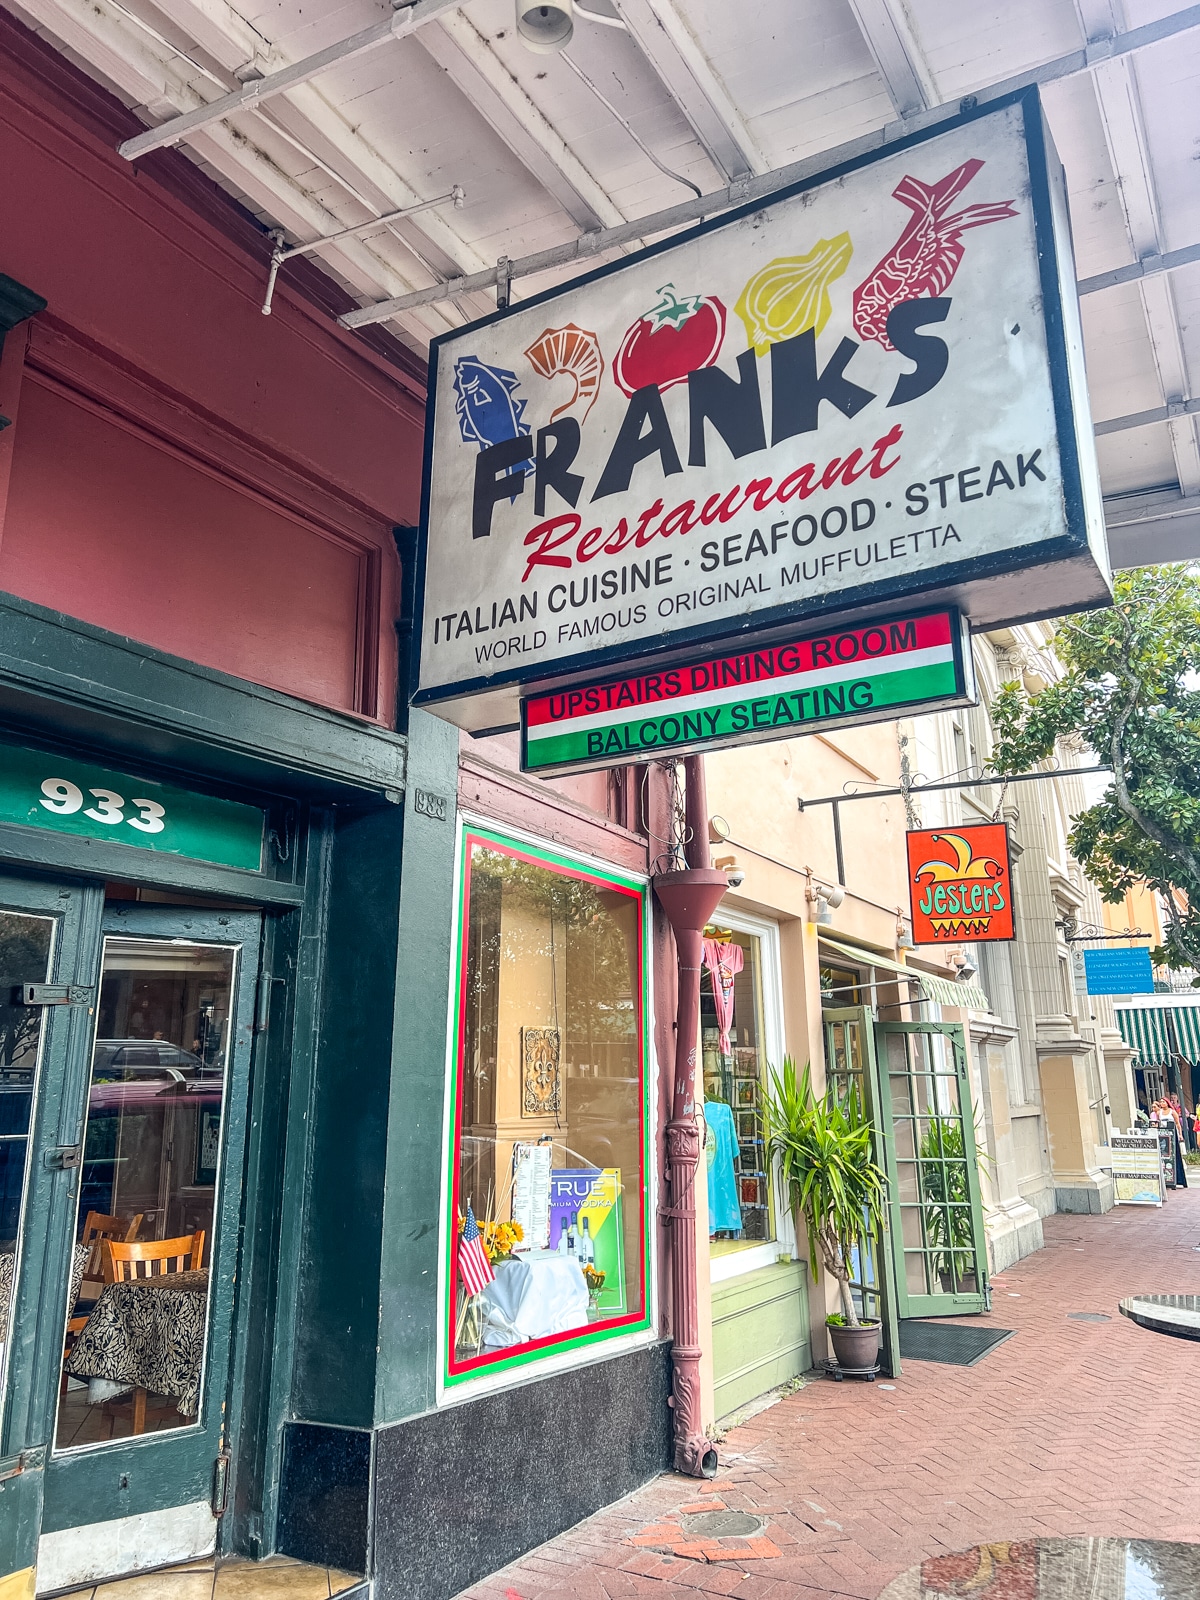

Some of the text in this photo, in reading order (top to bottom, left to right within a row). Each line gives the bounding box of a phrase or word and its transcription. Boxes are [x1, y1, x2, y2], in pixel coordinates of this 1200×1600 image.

[473, 297, 952, 539] FRANKS
[434, 449, 1047, 645] ITALIAN CUISINE SEAFOOD STEAK
[521, 424, 904, 582] Restaurant
[475, 523, 962, 663] WORLD FAMOUS ORIGINAL MUFFULETTA
[549, 621, 918, 719] UPSTAIRS DINING ROOM
[586, 681, 874, 756] BALCONY SEATING
[38, 778, 166, 834] 933
[573, 1200, 612, 1208] VODKA
